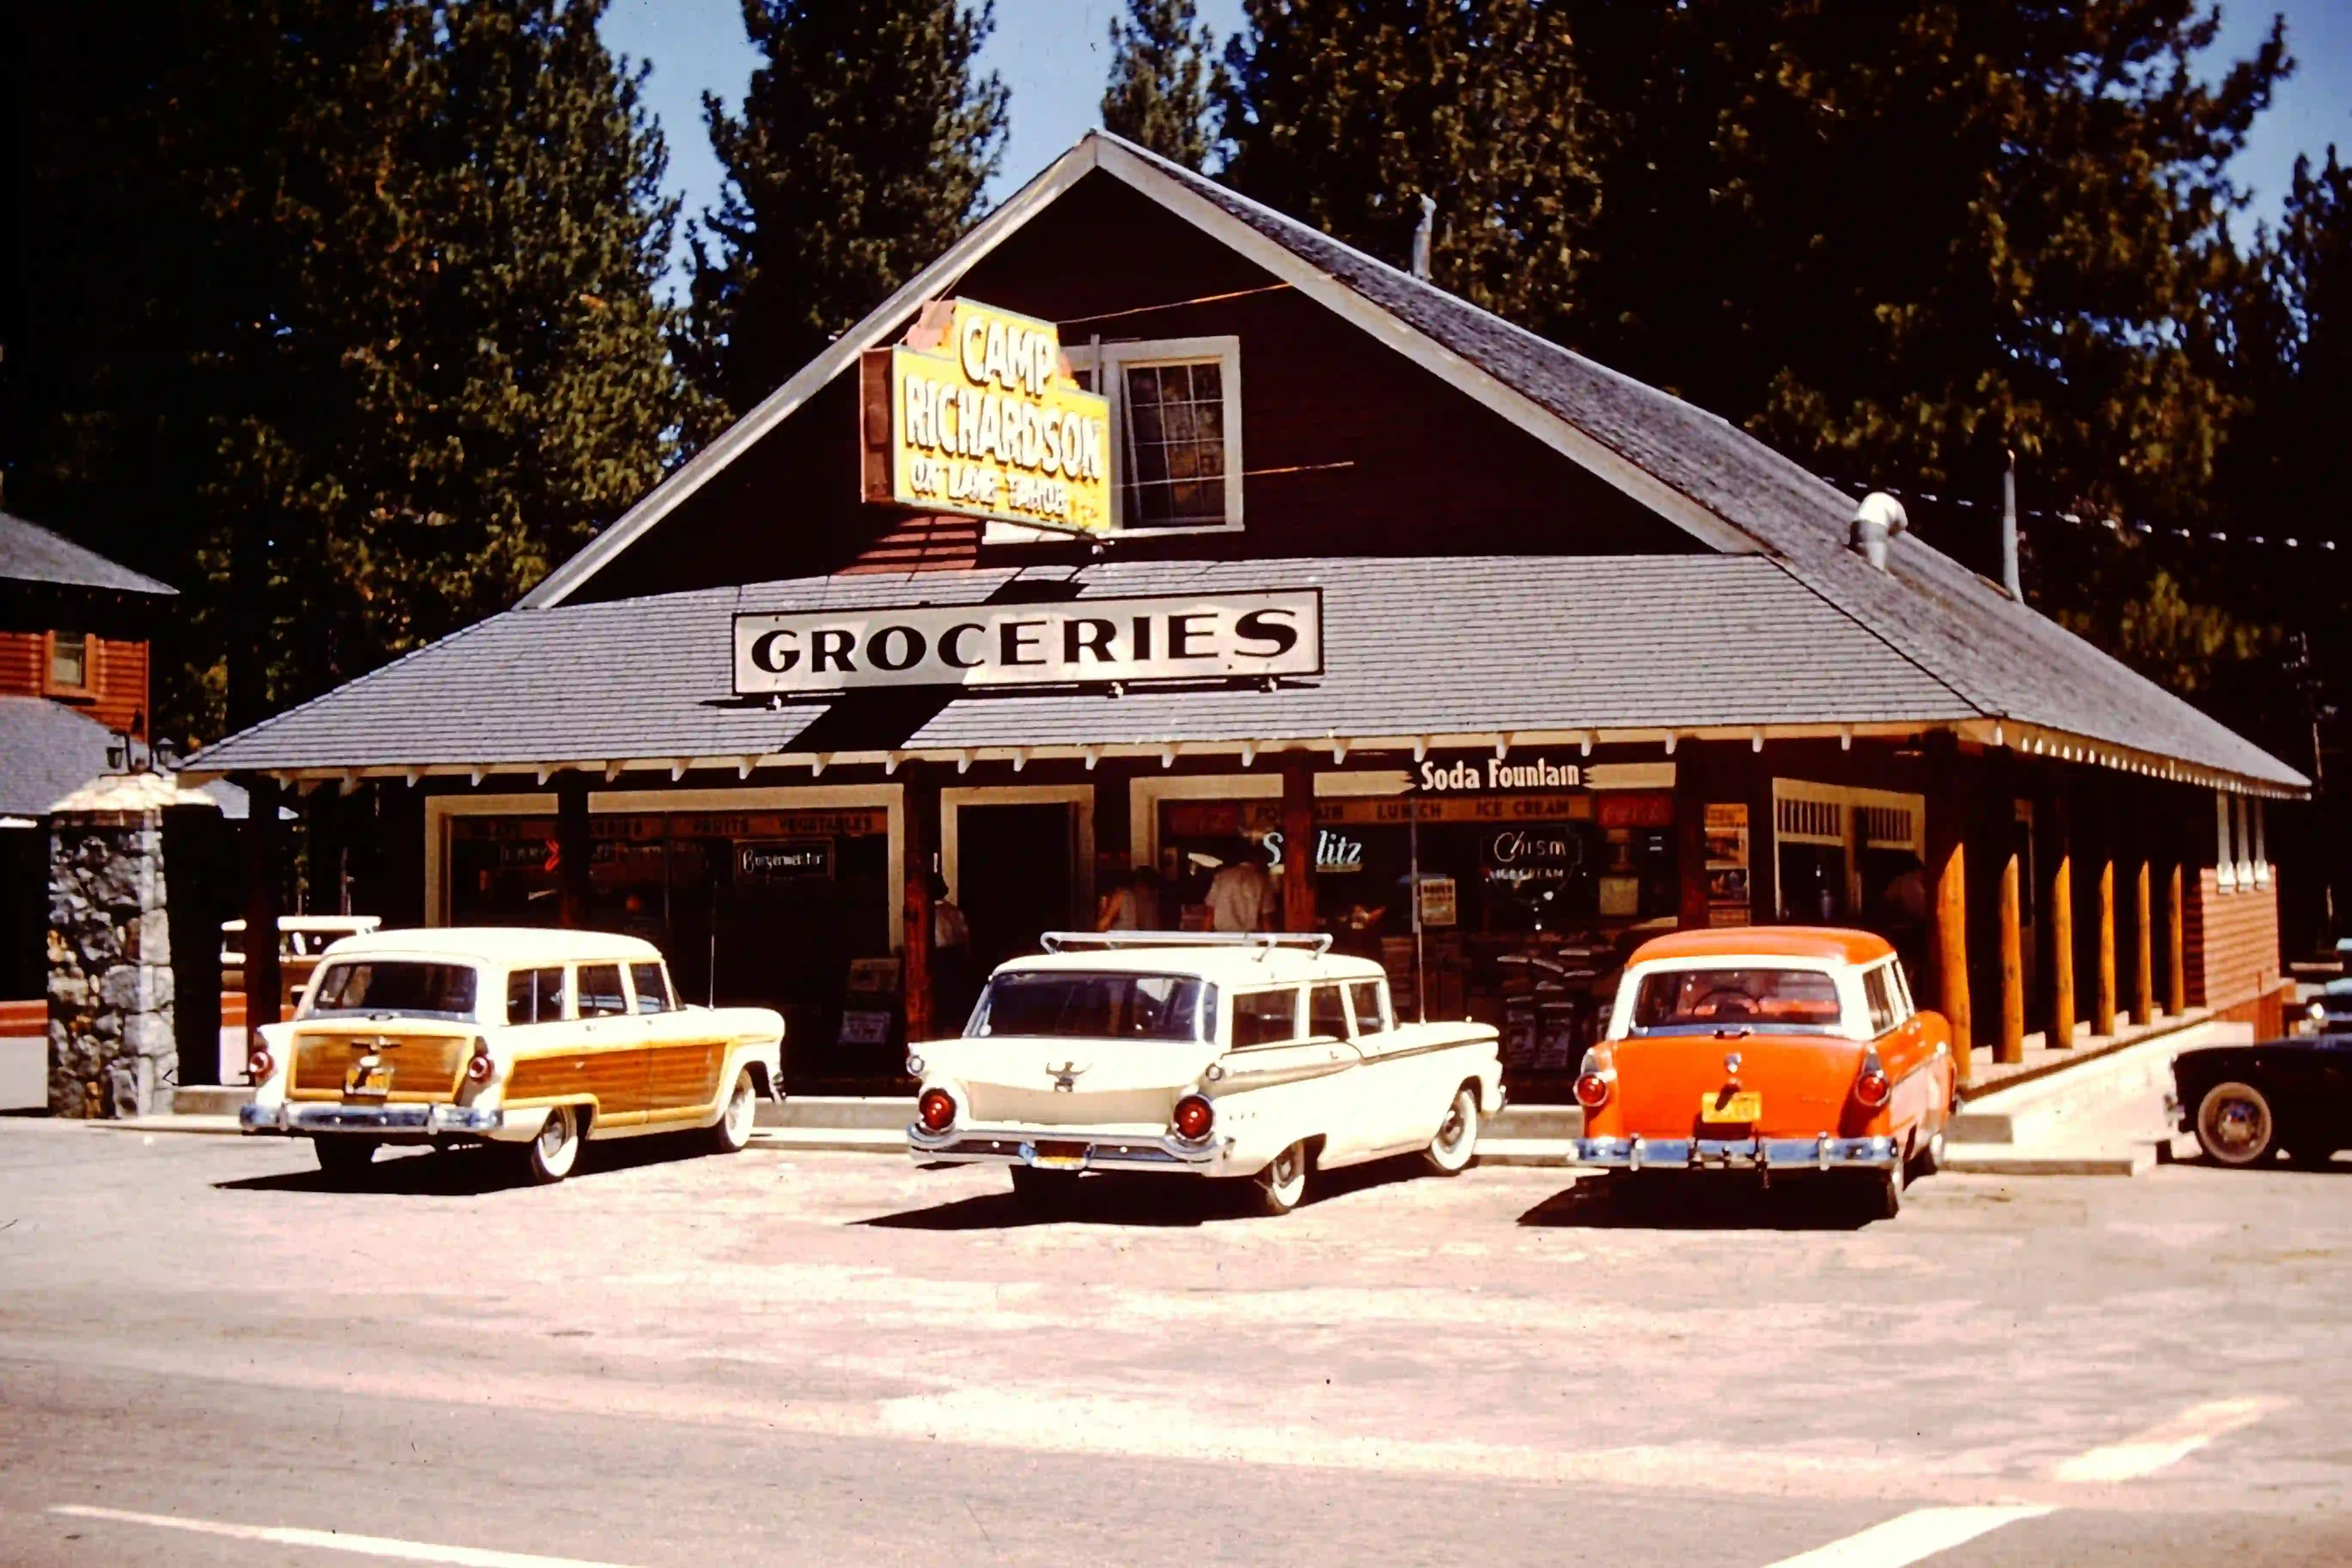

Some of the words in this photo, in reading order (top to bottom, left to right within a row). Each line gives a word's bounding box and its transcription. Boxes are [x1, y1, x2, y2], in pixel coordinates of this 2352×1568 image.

[961, 315, 1053, 395] CAMP
[904, 374, 1101, 481] RICHARDSON
[751, 609, 1298, 674] GROCERIES
[1421, 760, 1480, 790] Soda
[1488, 757, 1580, 788] Fountain
[1377, 802, 1442, 818] LUNCH
[1475, 799, 1503, 817] ICE
[1513, 799, 1570, 815] CREAM
[1262, 830, 1362, 867] Slitz
